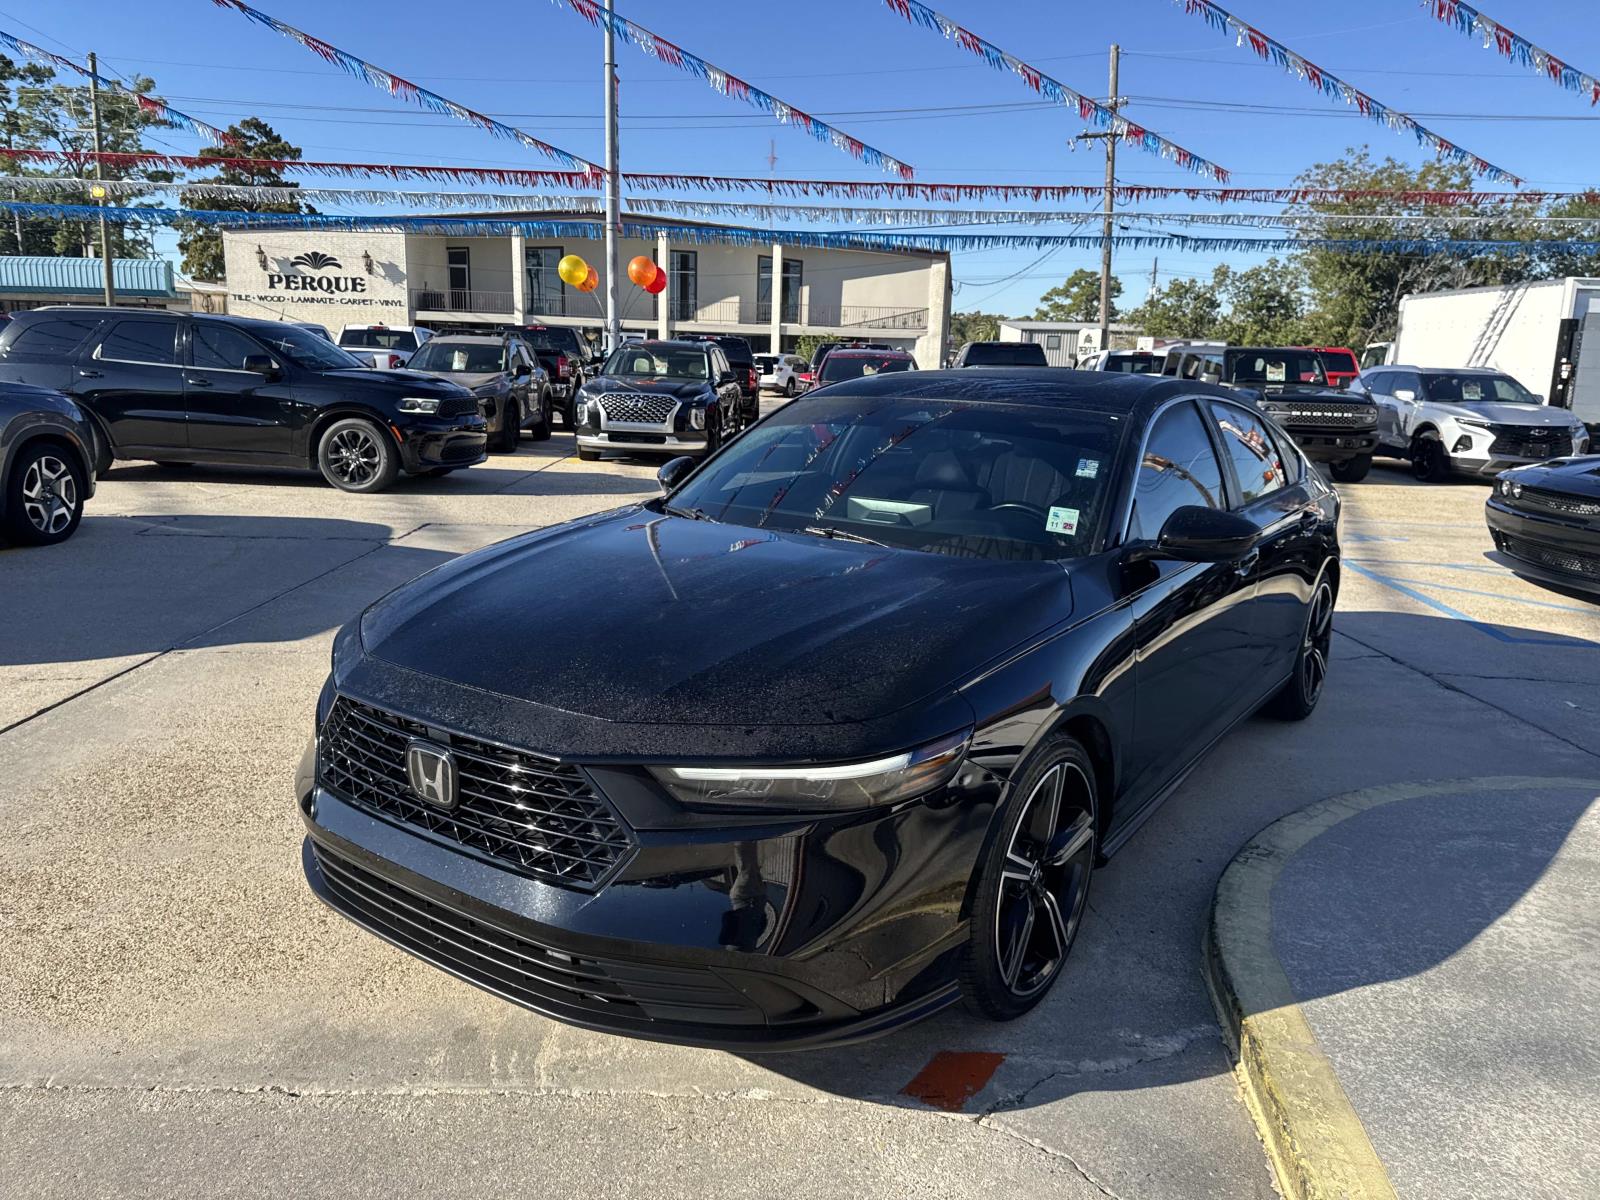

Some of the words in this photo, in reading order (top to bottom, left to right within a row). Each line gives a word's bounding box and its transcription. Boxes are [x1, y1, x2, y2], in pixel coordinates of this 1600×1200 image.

[268, 273, 367, 294] PERQUE
[232, 294, 251, 302] TILE
[257, 294, 286, 303] WOOD
[290, 295, 335, 304] LAMINATE
[340, 297, 375, 306] CARPET
[378, 299, 405, 307] VINYL
[1063, 522, 1073, 530] 25
